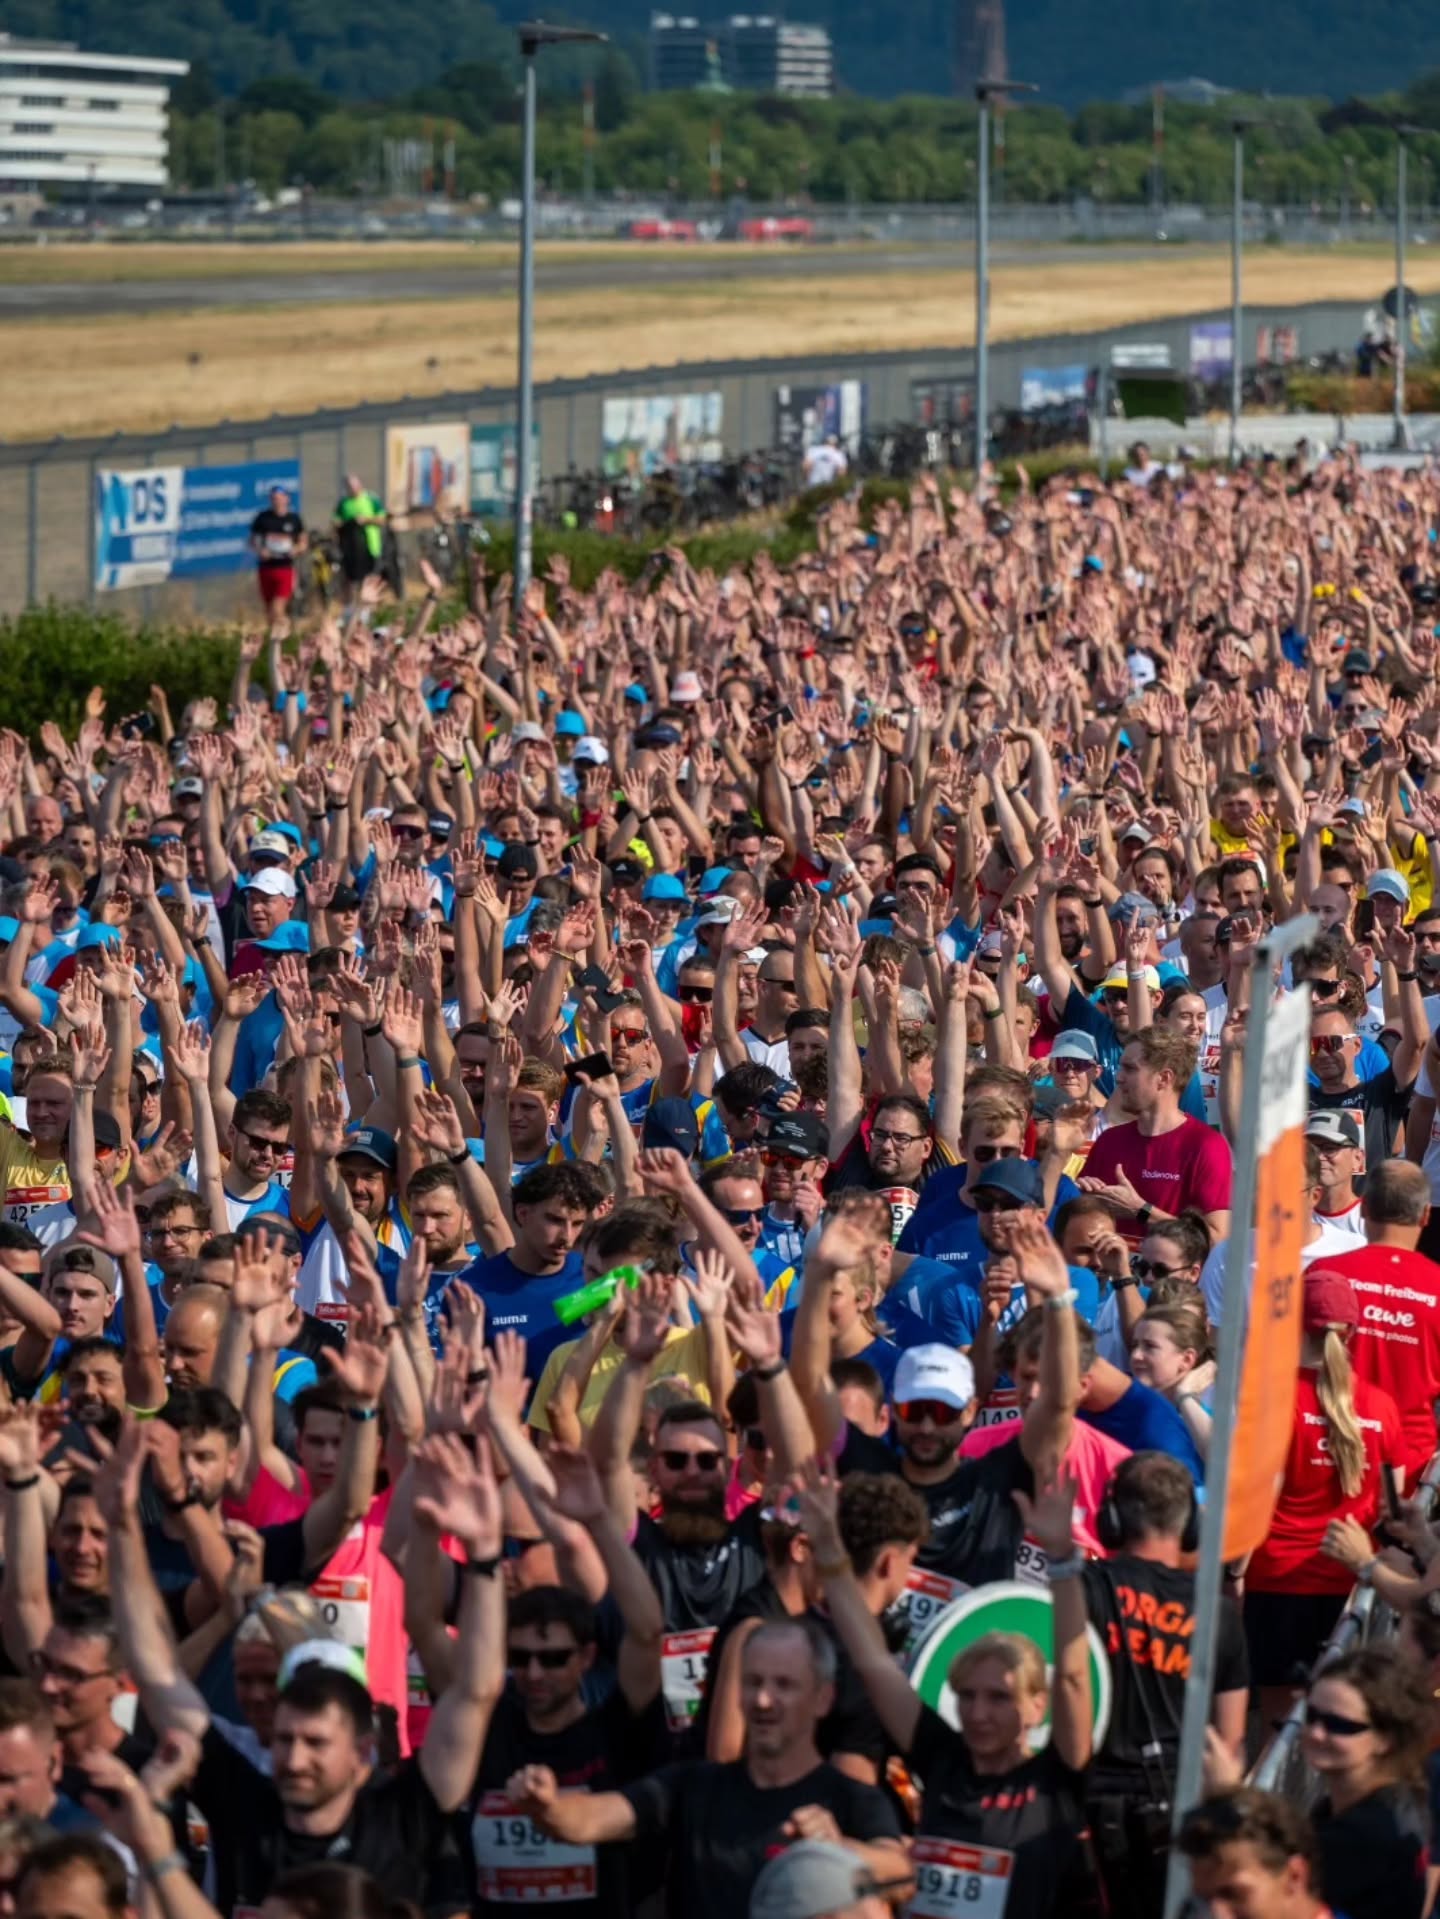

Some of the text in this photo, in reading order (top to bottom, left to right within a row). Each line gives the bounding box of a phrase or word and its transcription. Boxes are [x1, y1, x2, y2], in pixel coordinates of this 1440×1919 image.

[1347, 1278, 1437, 1307] Team Freiburg
[492, 1314, 528, 1326] auma
[1363, 1304, 1416, 1328] cewe
